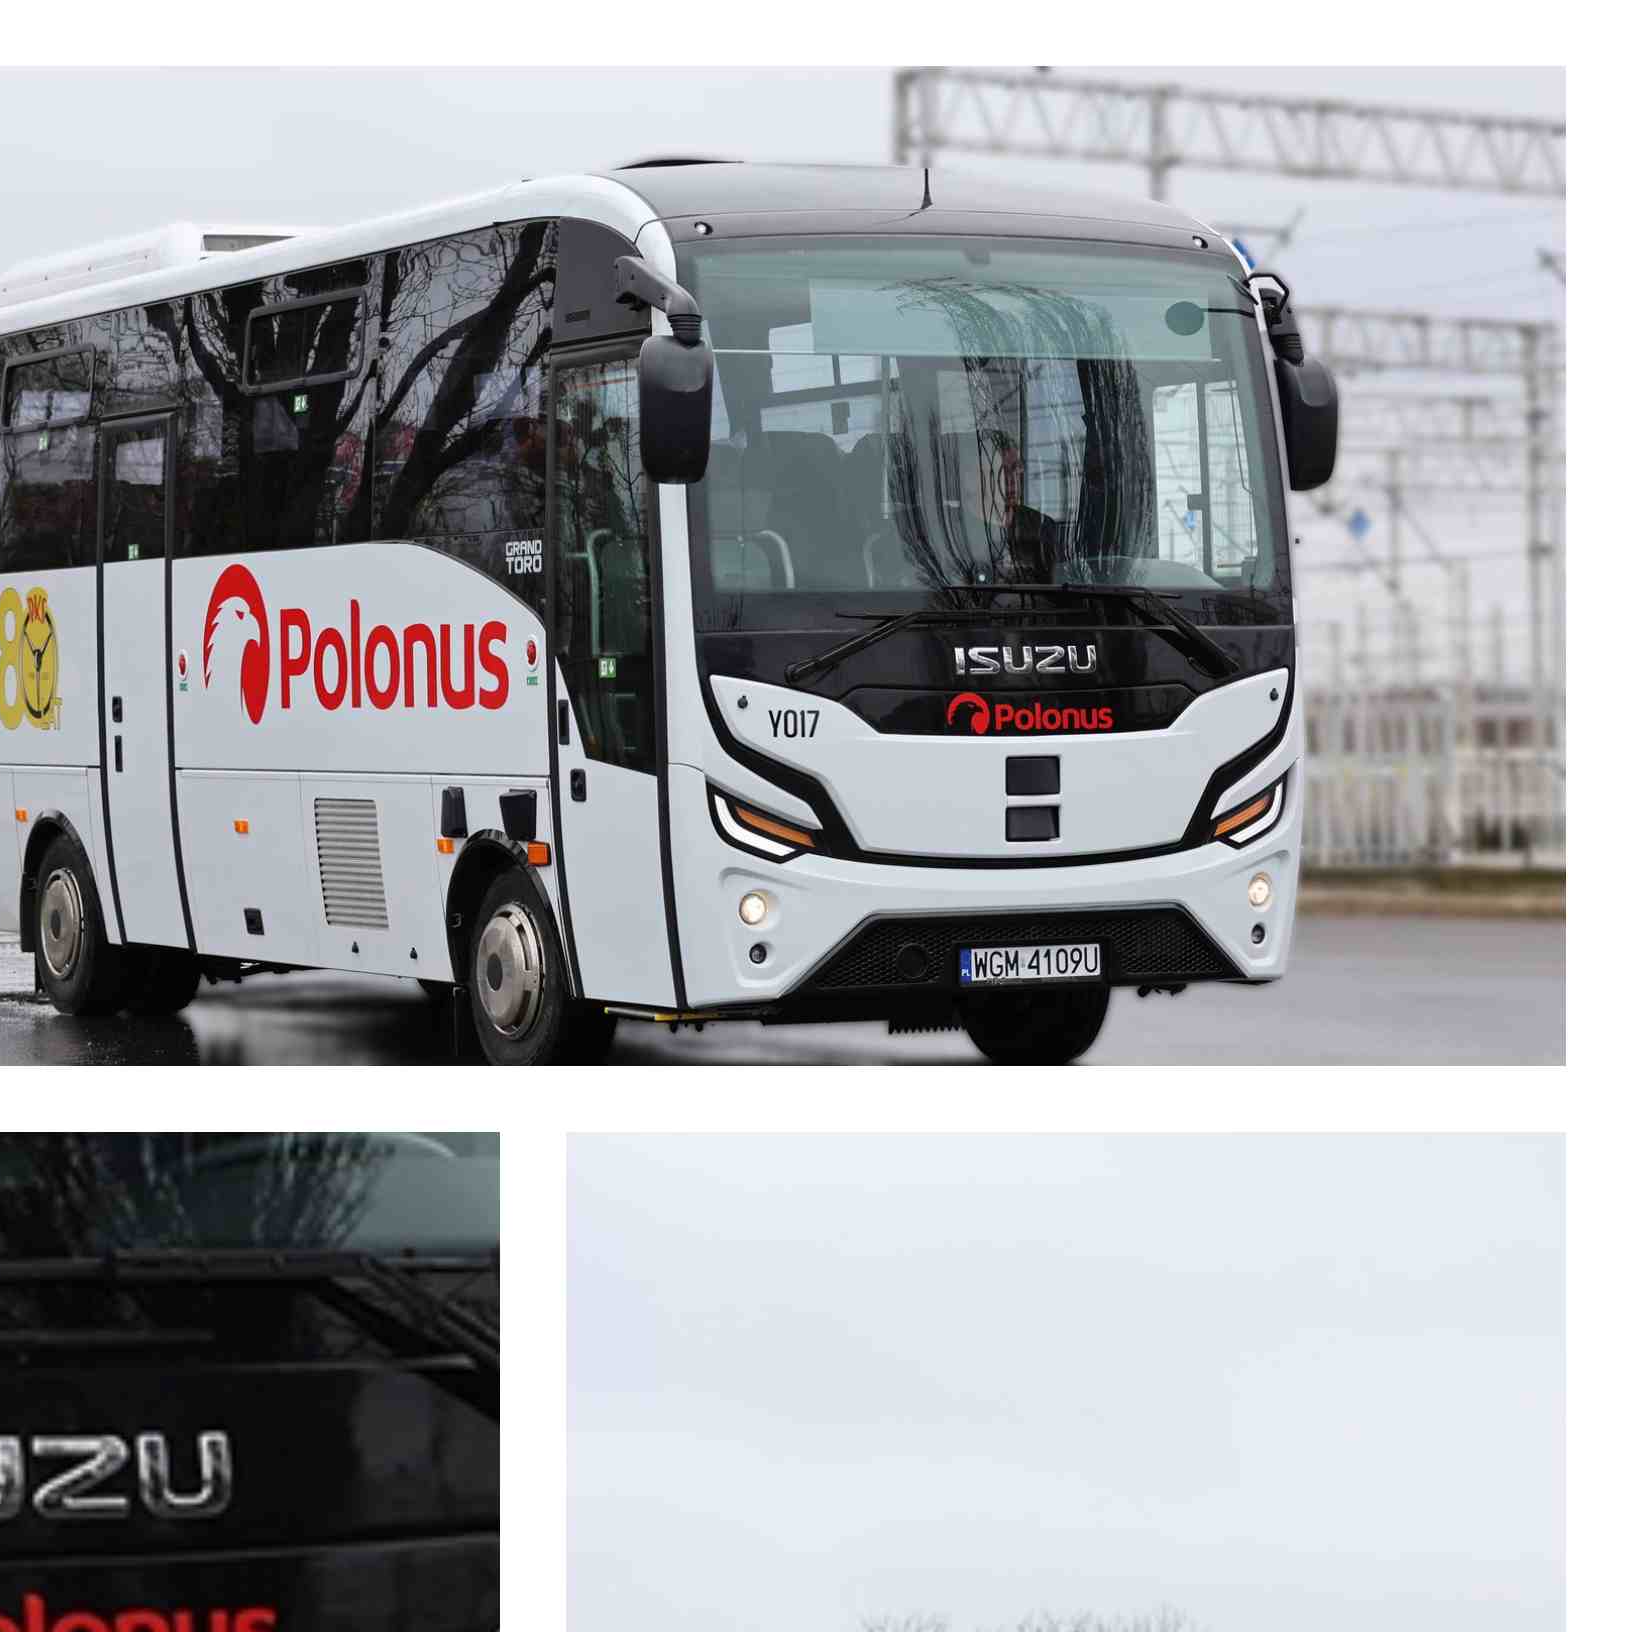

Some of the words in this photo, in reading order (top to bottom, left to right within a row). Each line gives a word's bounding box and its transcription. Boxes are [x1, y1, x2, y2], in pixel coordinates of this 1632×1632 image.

[505, 540, 542, 556] GRAND
[505, 555, 543, 575] TORO
[280, 598, 510, 710] Polonus
[954, 645, 1097, 675] ISUZU
[768, 710, 820, 739] Y017
[994, 702, 1114, 731] Polonus
[974, 951, 1019, 978] WGM
[1027, 946, 1099, 976] 4109U
